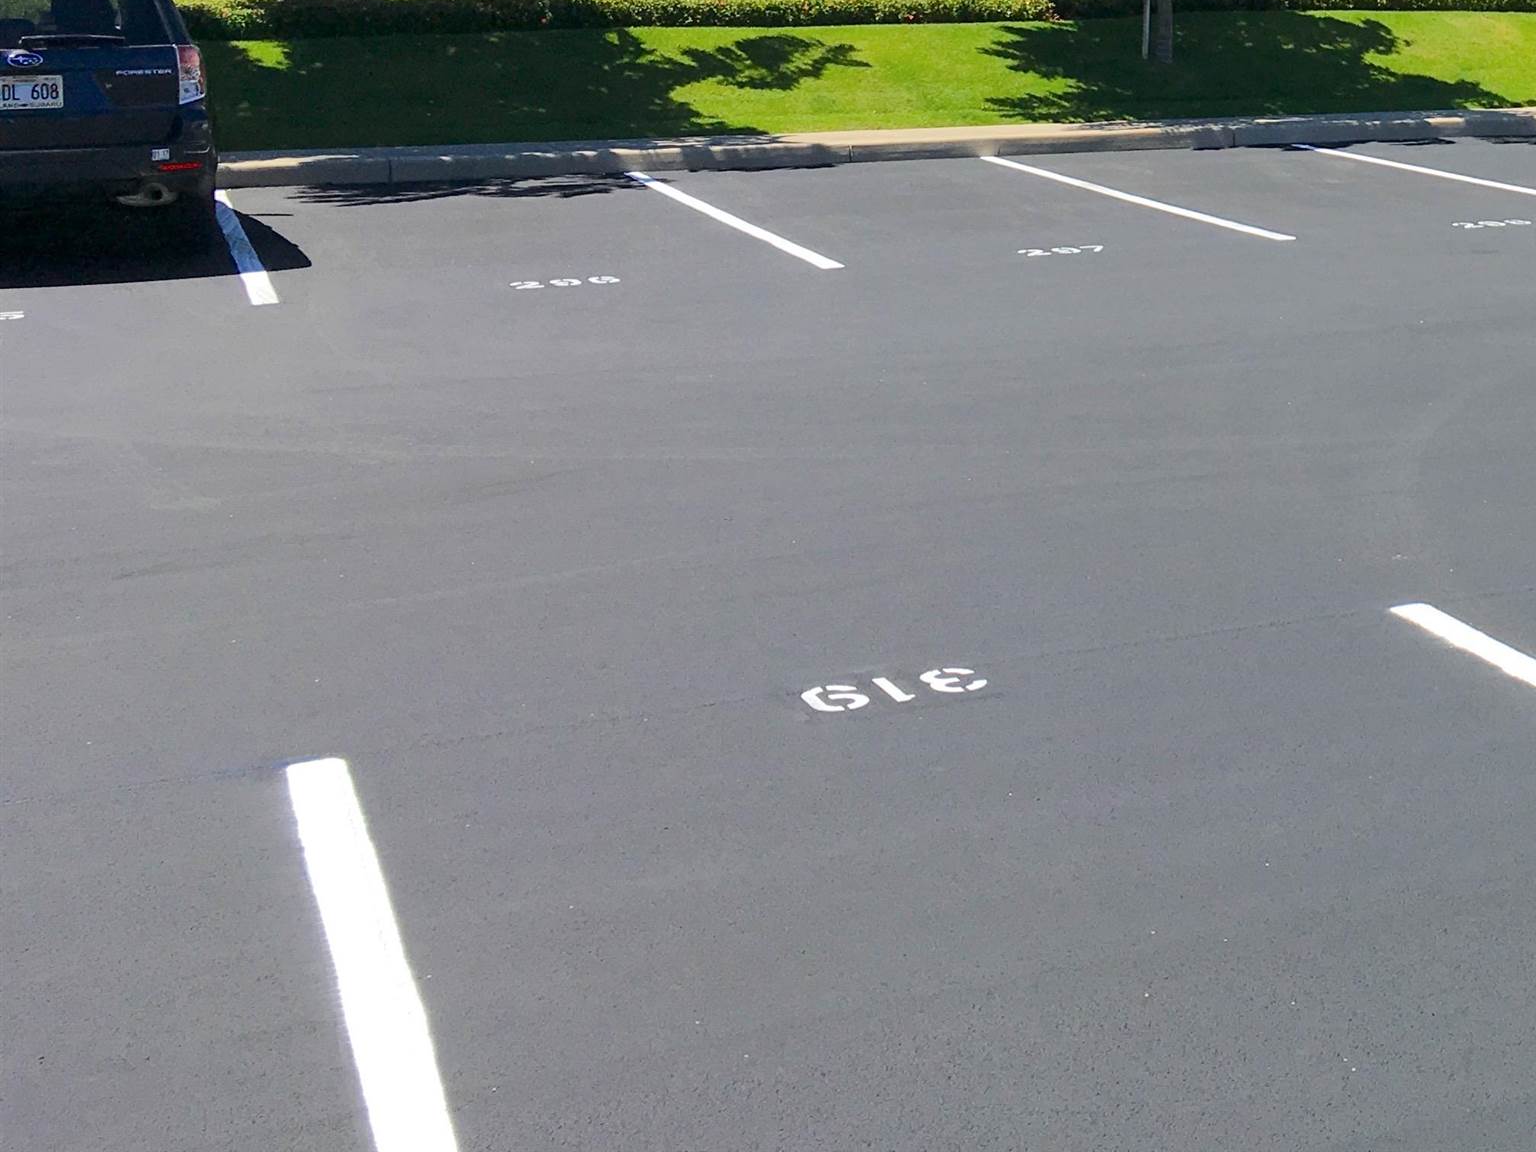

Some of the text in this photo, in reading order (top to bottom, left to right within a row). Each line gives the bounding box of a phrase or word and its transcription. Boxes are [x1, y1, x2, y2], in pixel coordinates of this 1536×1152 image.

[115, 68, 173, 77] FORESTER
[31, 82, 60, 100] 608
[801, 667, 988, 712] 319
